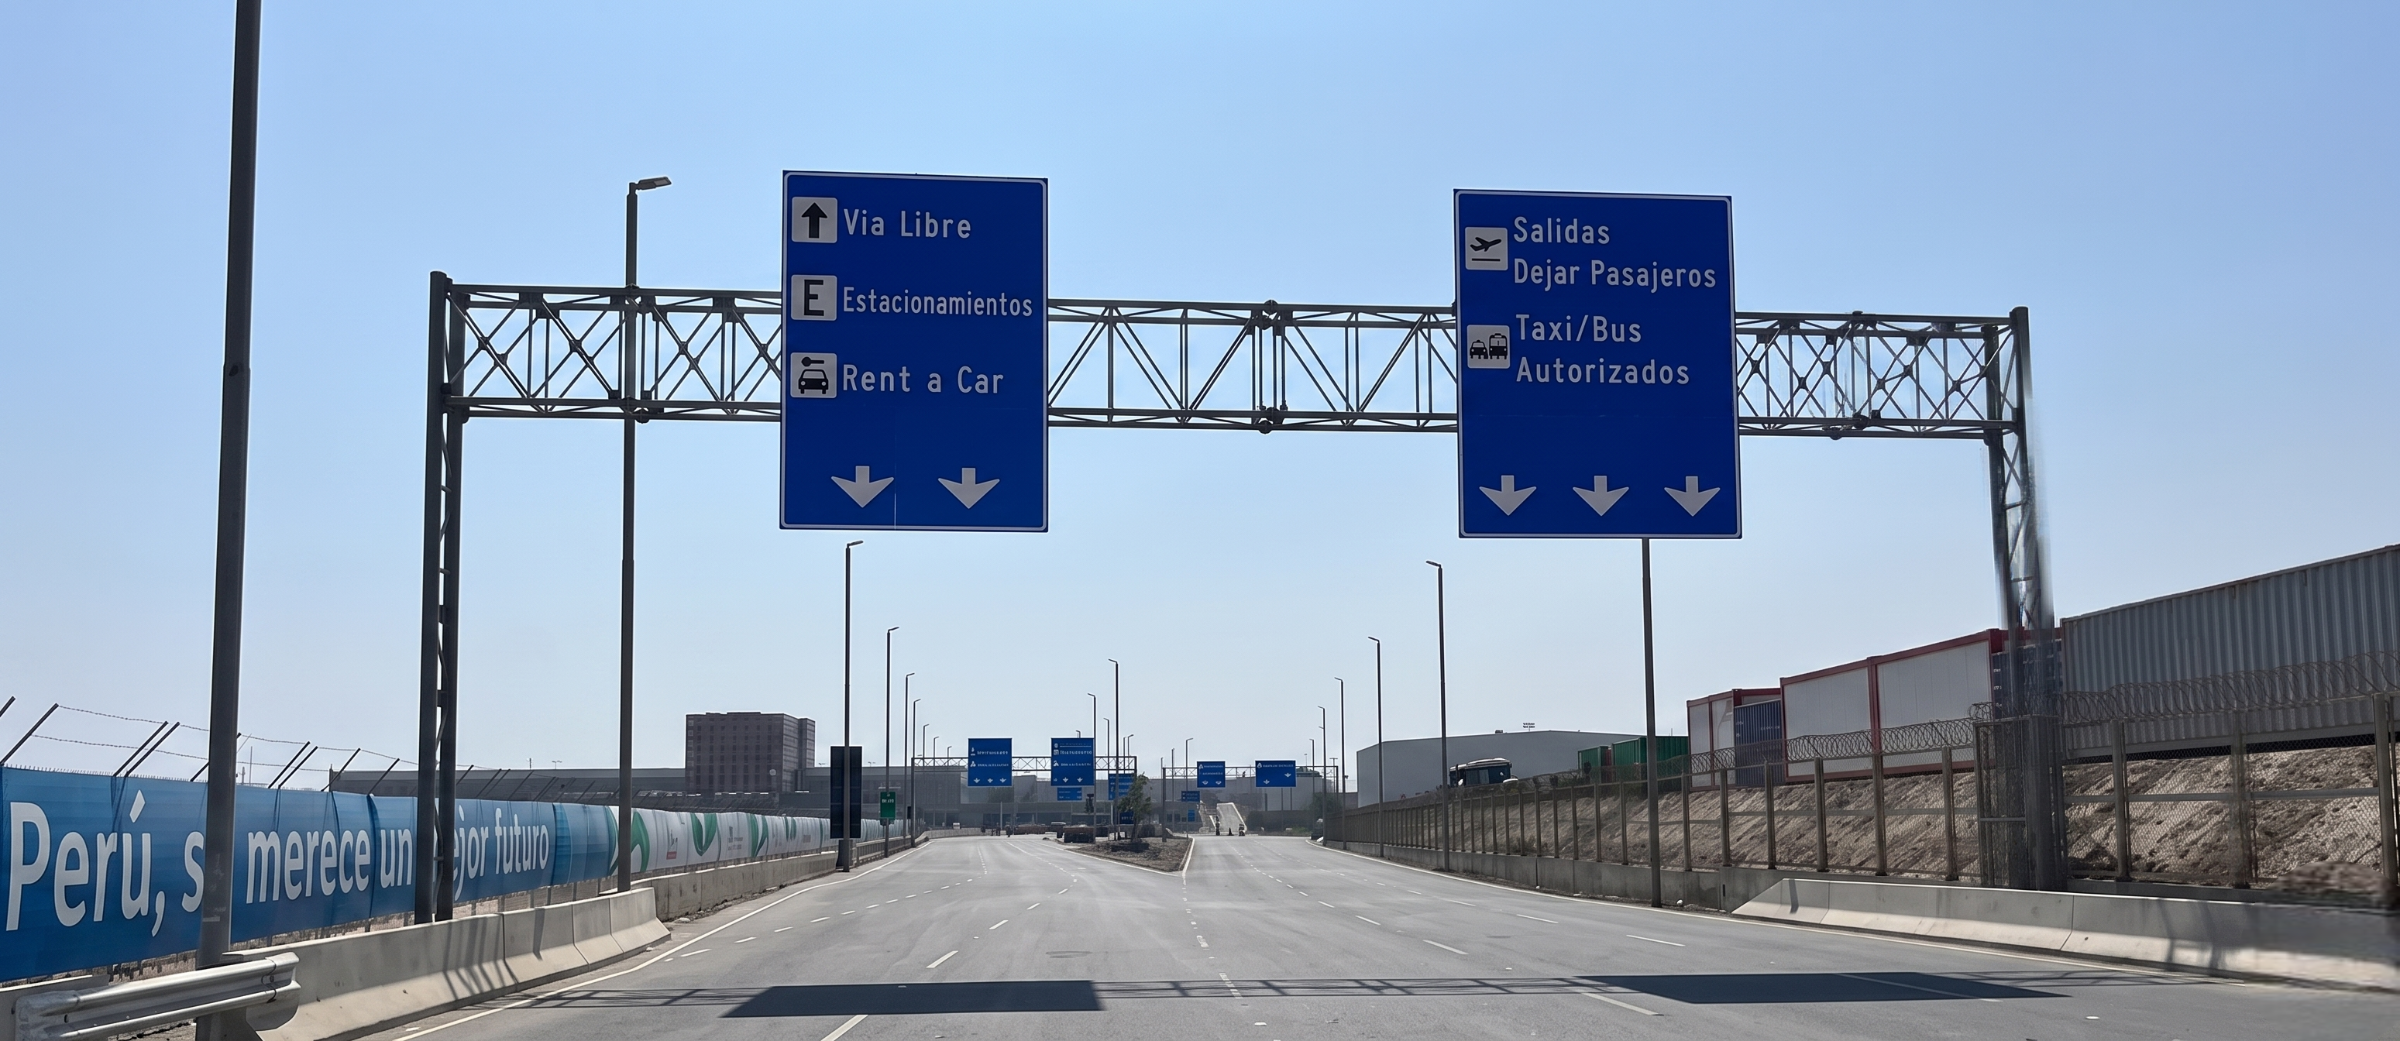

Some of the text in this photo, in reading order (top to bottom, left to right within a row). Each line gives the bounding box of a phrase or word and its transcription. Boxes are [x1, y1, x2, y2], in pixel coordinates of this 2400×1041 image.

[843, 208, 971, 239] Via Libre
[1513, 216, 1610, 245] Salidas
[1514, 258, 1716, 294] Dejar Pasajeros
[803, 279, 825, 317] E
[843, 286, 1033, 317] Estacionamientos
[1515, 313, 1642, 343] Taxi/Bus
[843, 364, 1004, 394] Rent a Car
[1516, 356, 1690, 385] Autorizados
[6, 789, 166, 937] Perú,
[246, 829, 371, 904] merece
[380, 828, 413, 889] un
[495, 807, 549, 875] futuro
